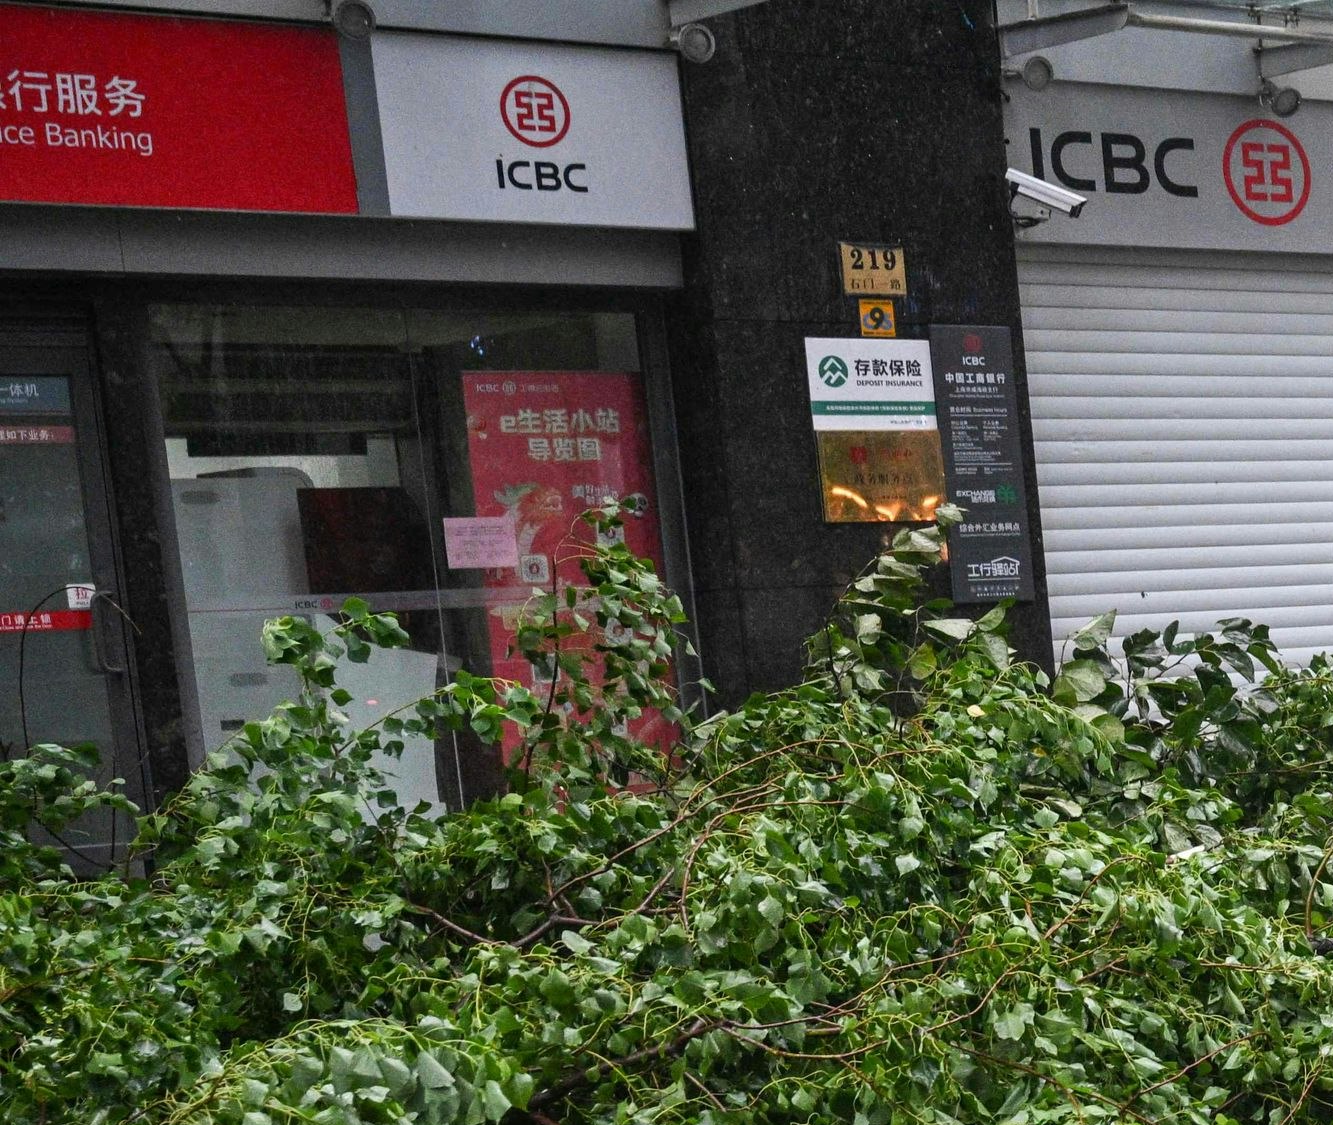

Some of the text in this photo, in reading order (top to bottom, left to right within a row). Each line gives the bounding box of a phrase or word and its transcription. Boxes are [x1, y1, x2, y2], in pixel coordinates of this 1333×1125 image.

[0, 69, 146, 118] 行服务
[0, 121, 154, 157] ce Banking
[1028, 127, 1200, 199] ICBC
[495, 158, 589, 193] ICBC
[850, 247, 896, 271] 219
[854, 359, 922, 377] 存款保险
[962, 356, 986, 366] ICBC
[856, 379, 923, 388] DEPOSIT INSURANCE
[945, 372, 1006, 385] 中国工商银行
